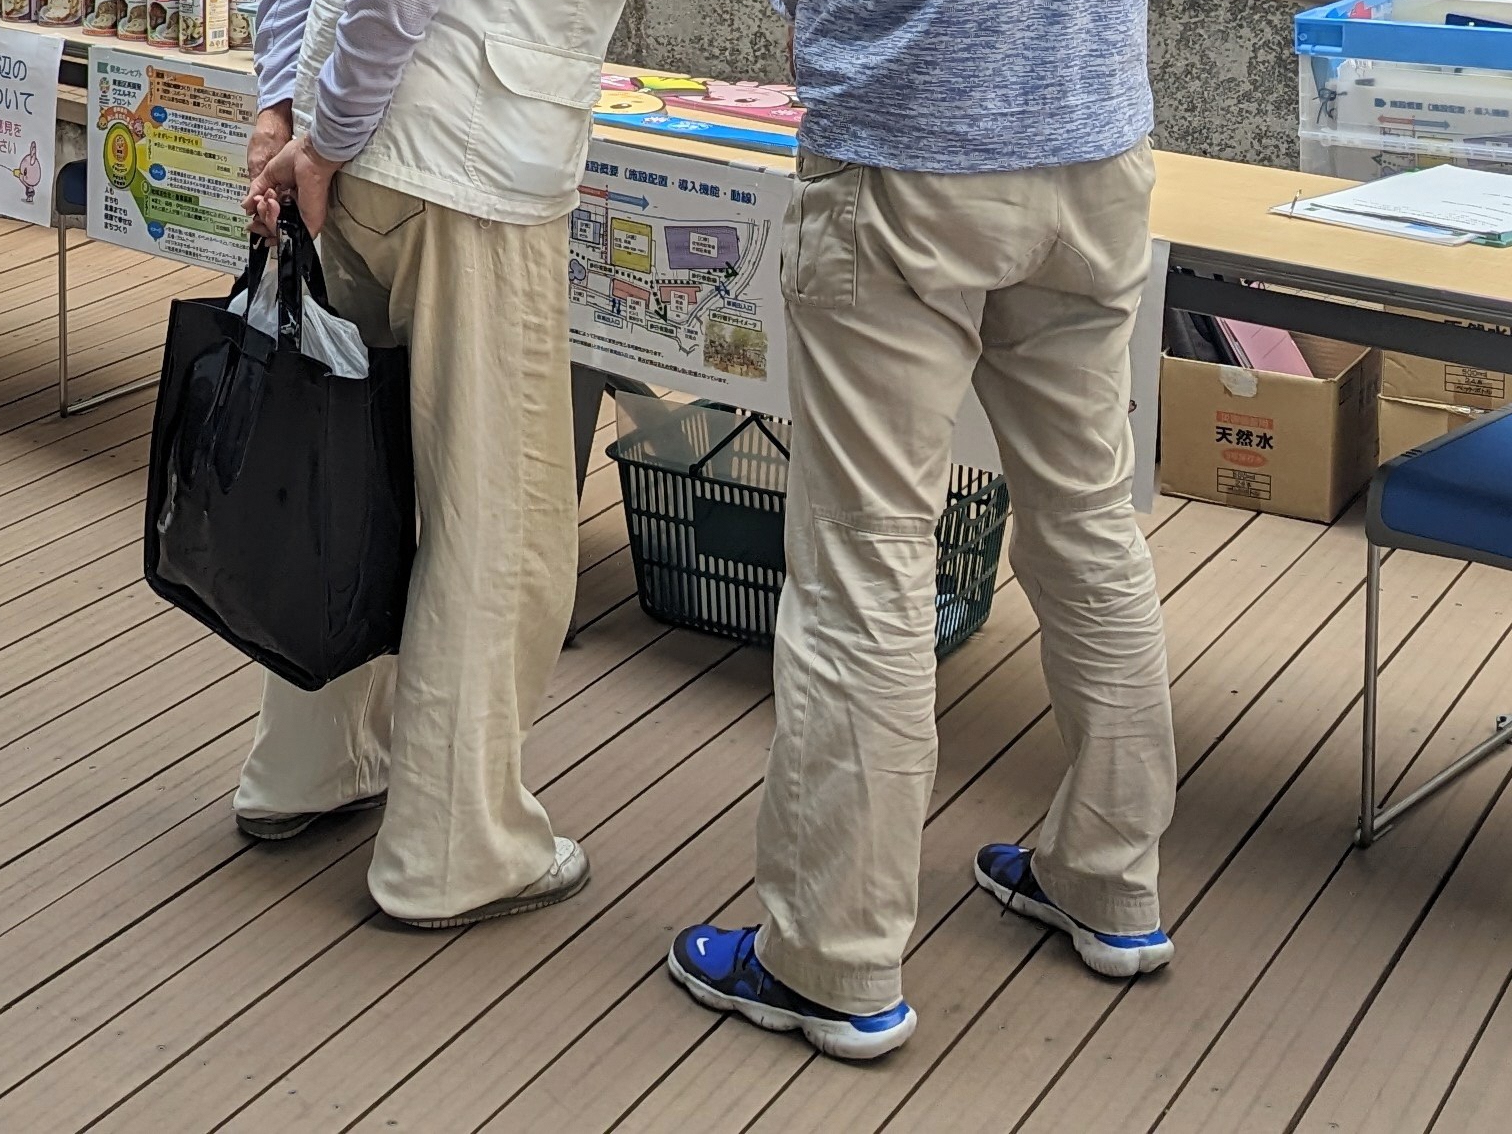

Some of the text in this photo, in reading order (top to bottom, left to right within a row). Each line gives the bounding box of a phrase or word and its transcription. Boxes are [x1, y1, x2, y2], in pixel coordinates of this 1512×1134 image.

[111, 97, 132, 107] フロント
[1215, 426, 1274, 450] 天然水
